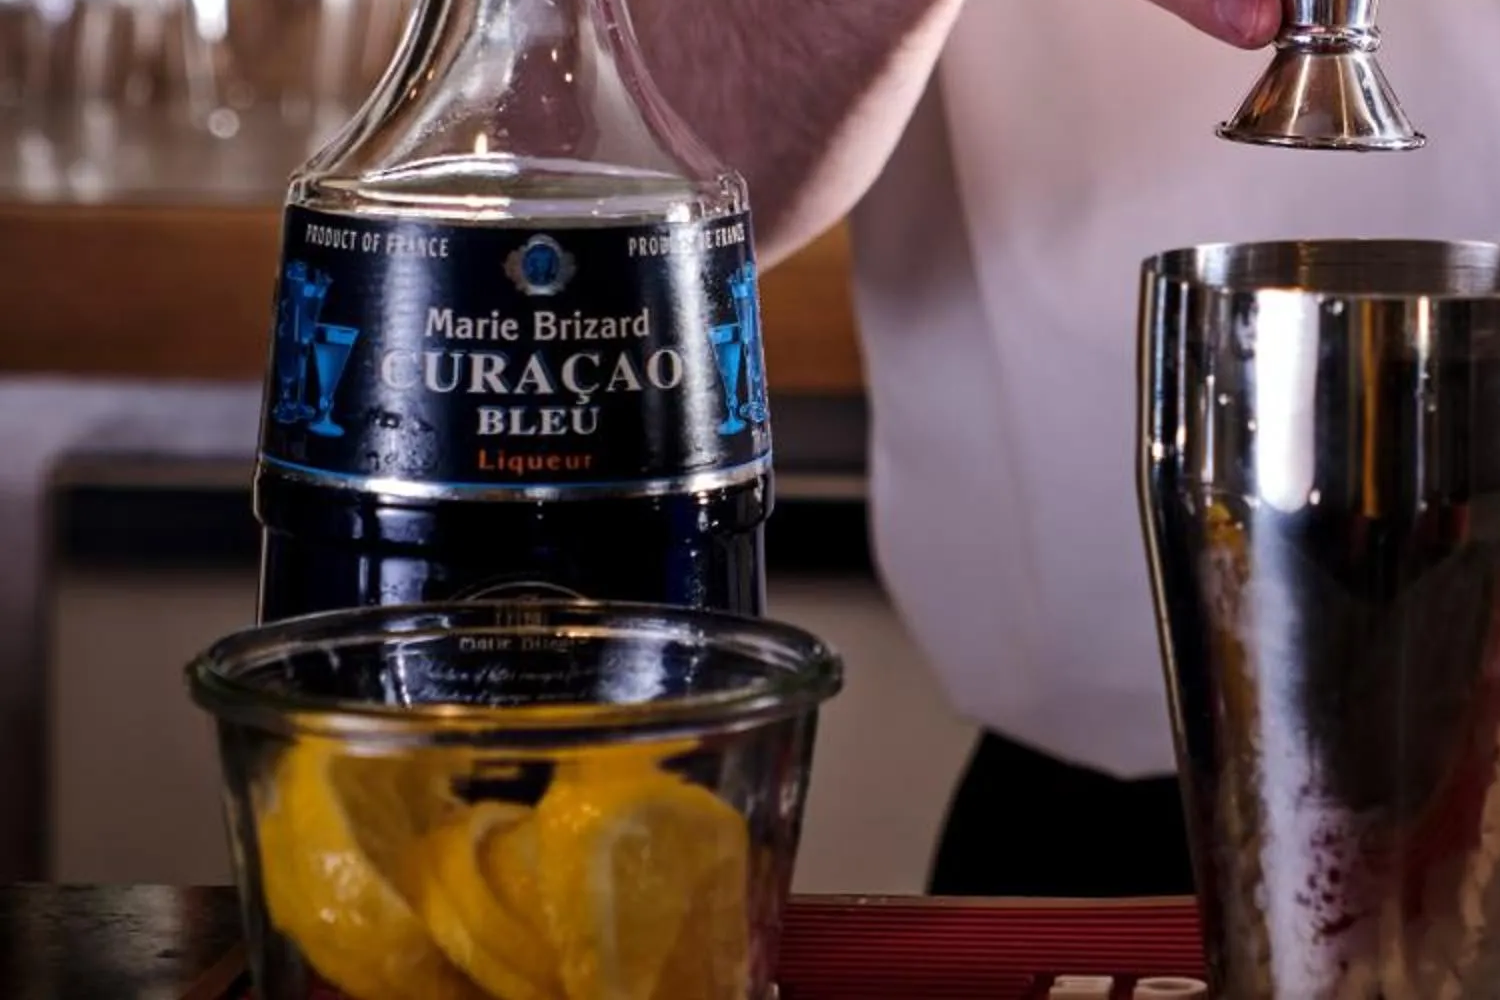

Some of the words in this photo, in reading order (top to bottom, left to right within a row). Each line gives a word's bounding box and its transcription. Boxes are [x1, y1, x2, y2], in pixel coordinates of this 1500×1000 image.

[305, 223, 357, 250] PRODUCT
[362, 231, 381, 253] OF
[386, 232, 449, 258] FRANCE
[425, 307, 519, 341] Marie
[533, 307, 650, 341] Brizard
[381, 350, 683, 404] CURAÇAO
[476, 406, 600, 436] BLEU
[478, 449, 593, 475] Liqueur
